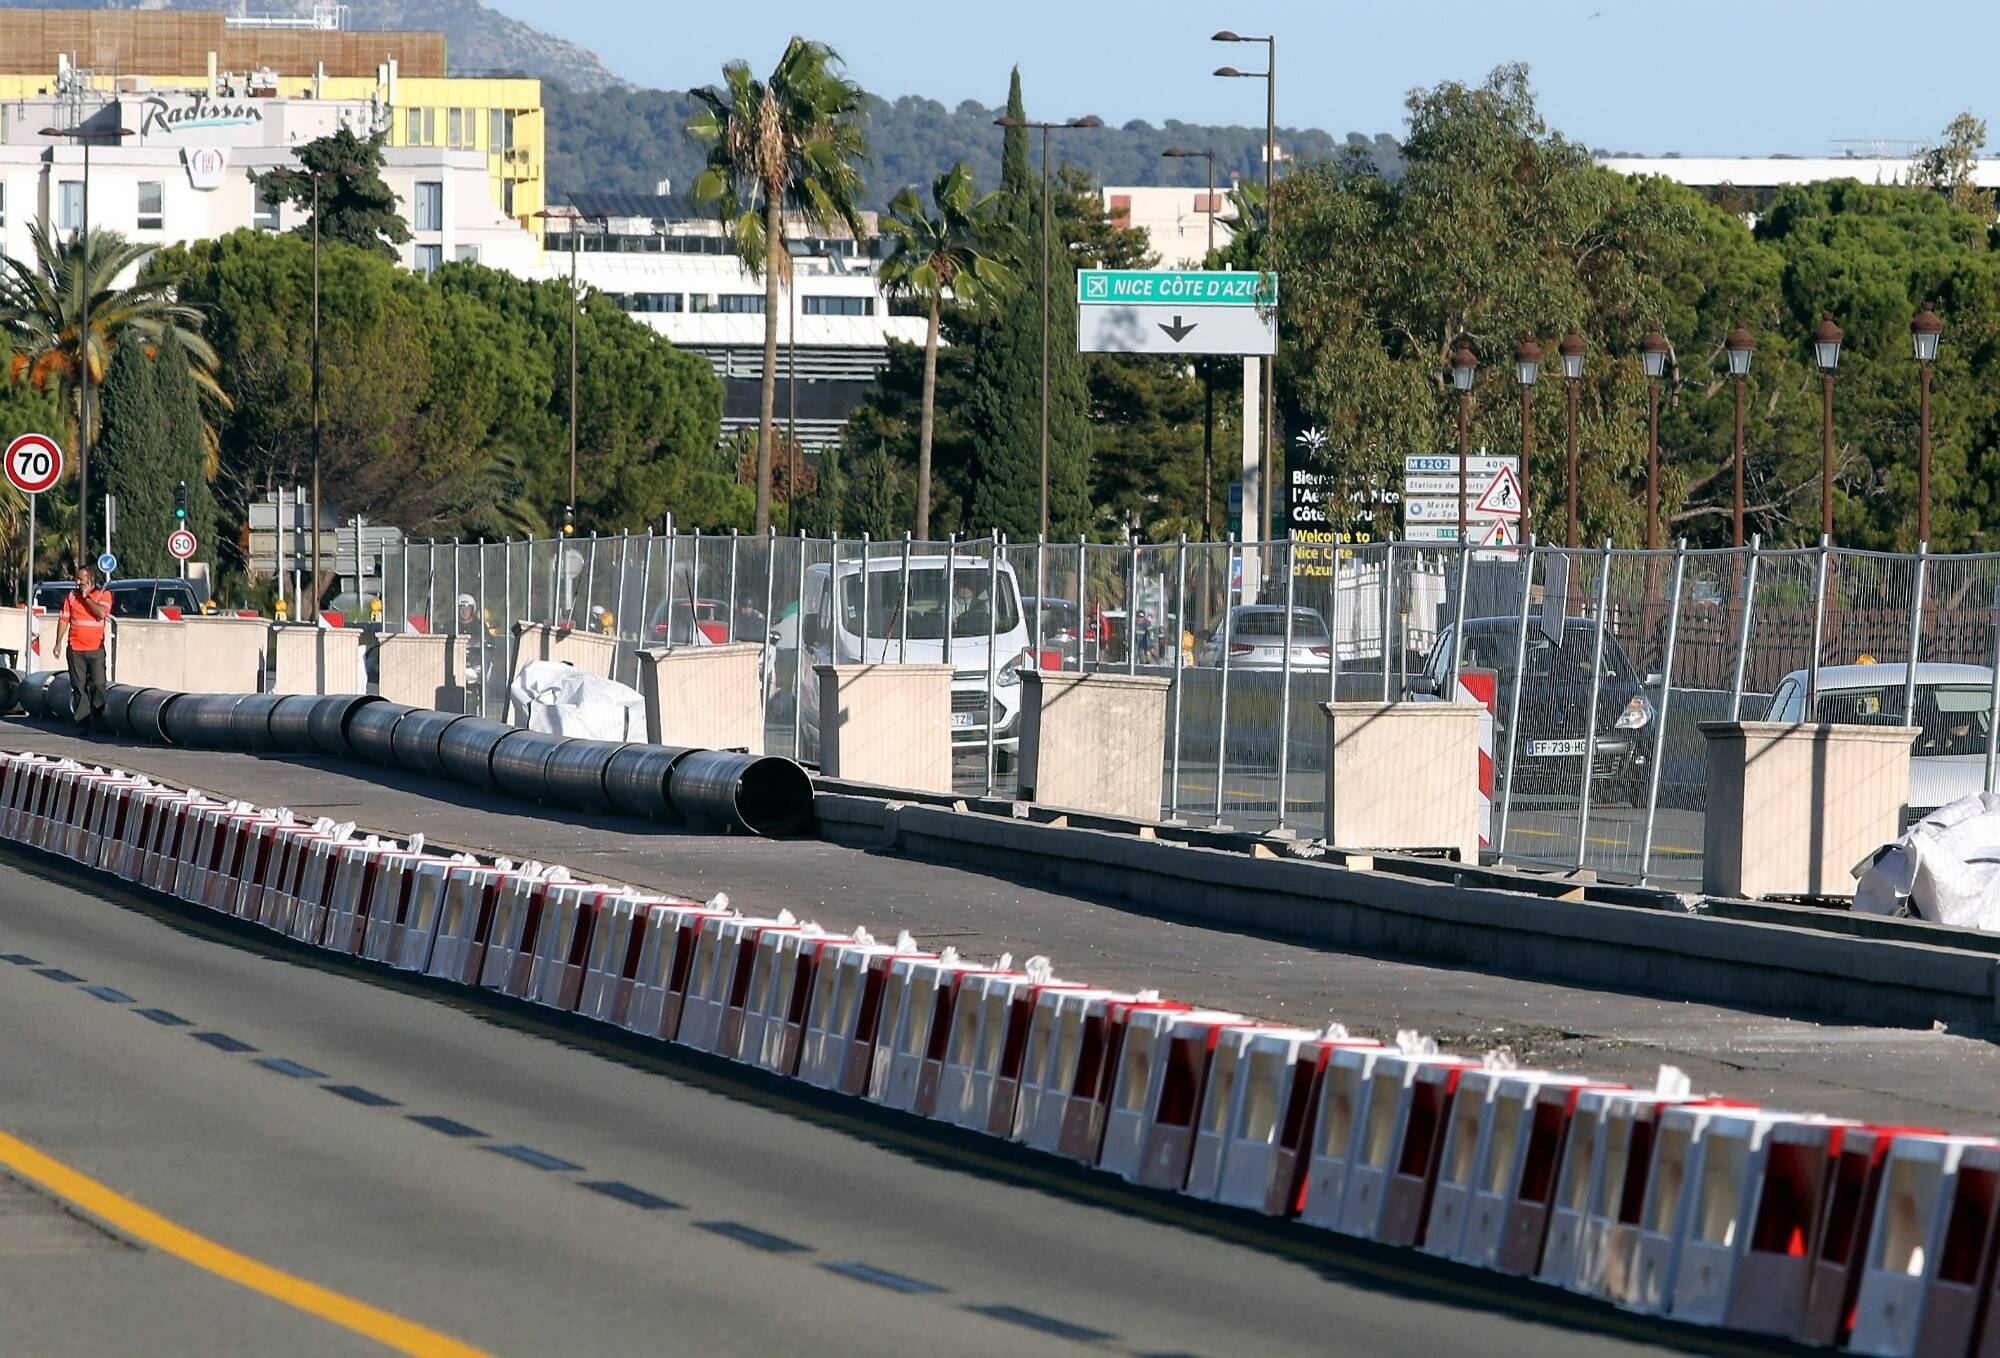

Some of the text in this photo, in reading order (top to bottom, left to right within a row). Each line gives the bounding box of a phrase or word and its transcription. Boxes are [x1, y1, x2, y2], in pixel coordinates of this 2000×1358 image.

[141, 91, 263, 137] Radisson
[1114, 276, 1258, 297] NICE CÔTE D'AZU
[18, 452, 50, 476] 70
[1408, 481, 1443, 489] Stations
[1445, 481, 1455, 489] de
[1426, 501, 1455, 509] Musée
[1356, 531, 1371, 543] to
[174, 538, 190, 550] 50
